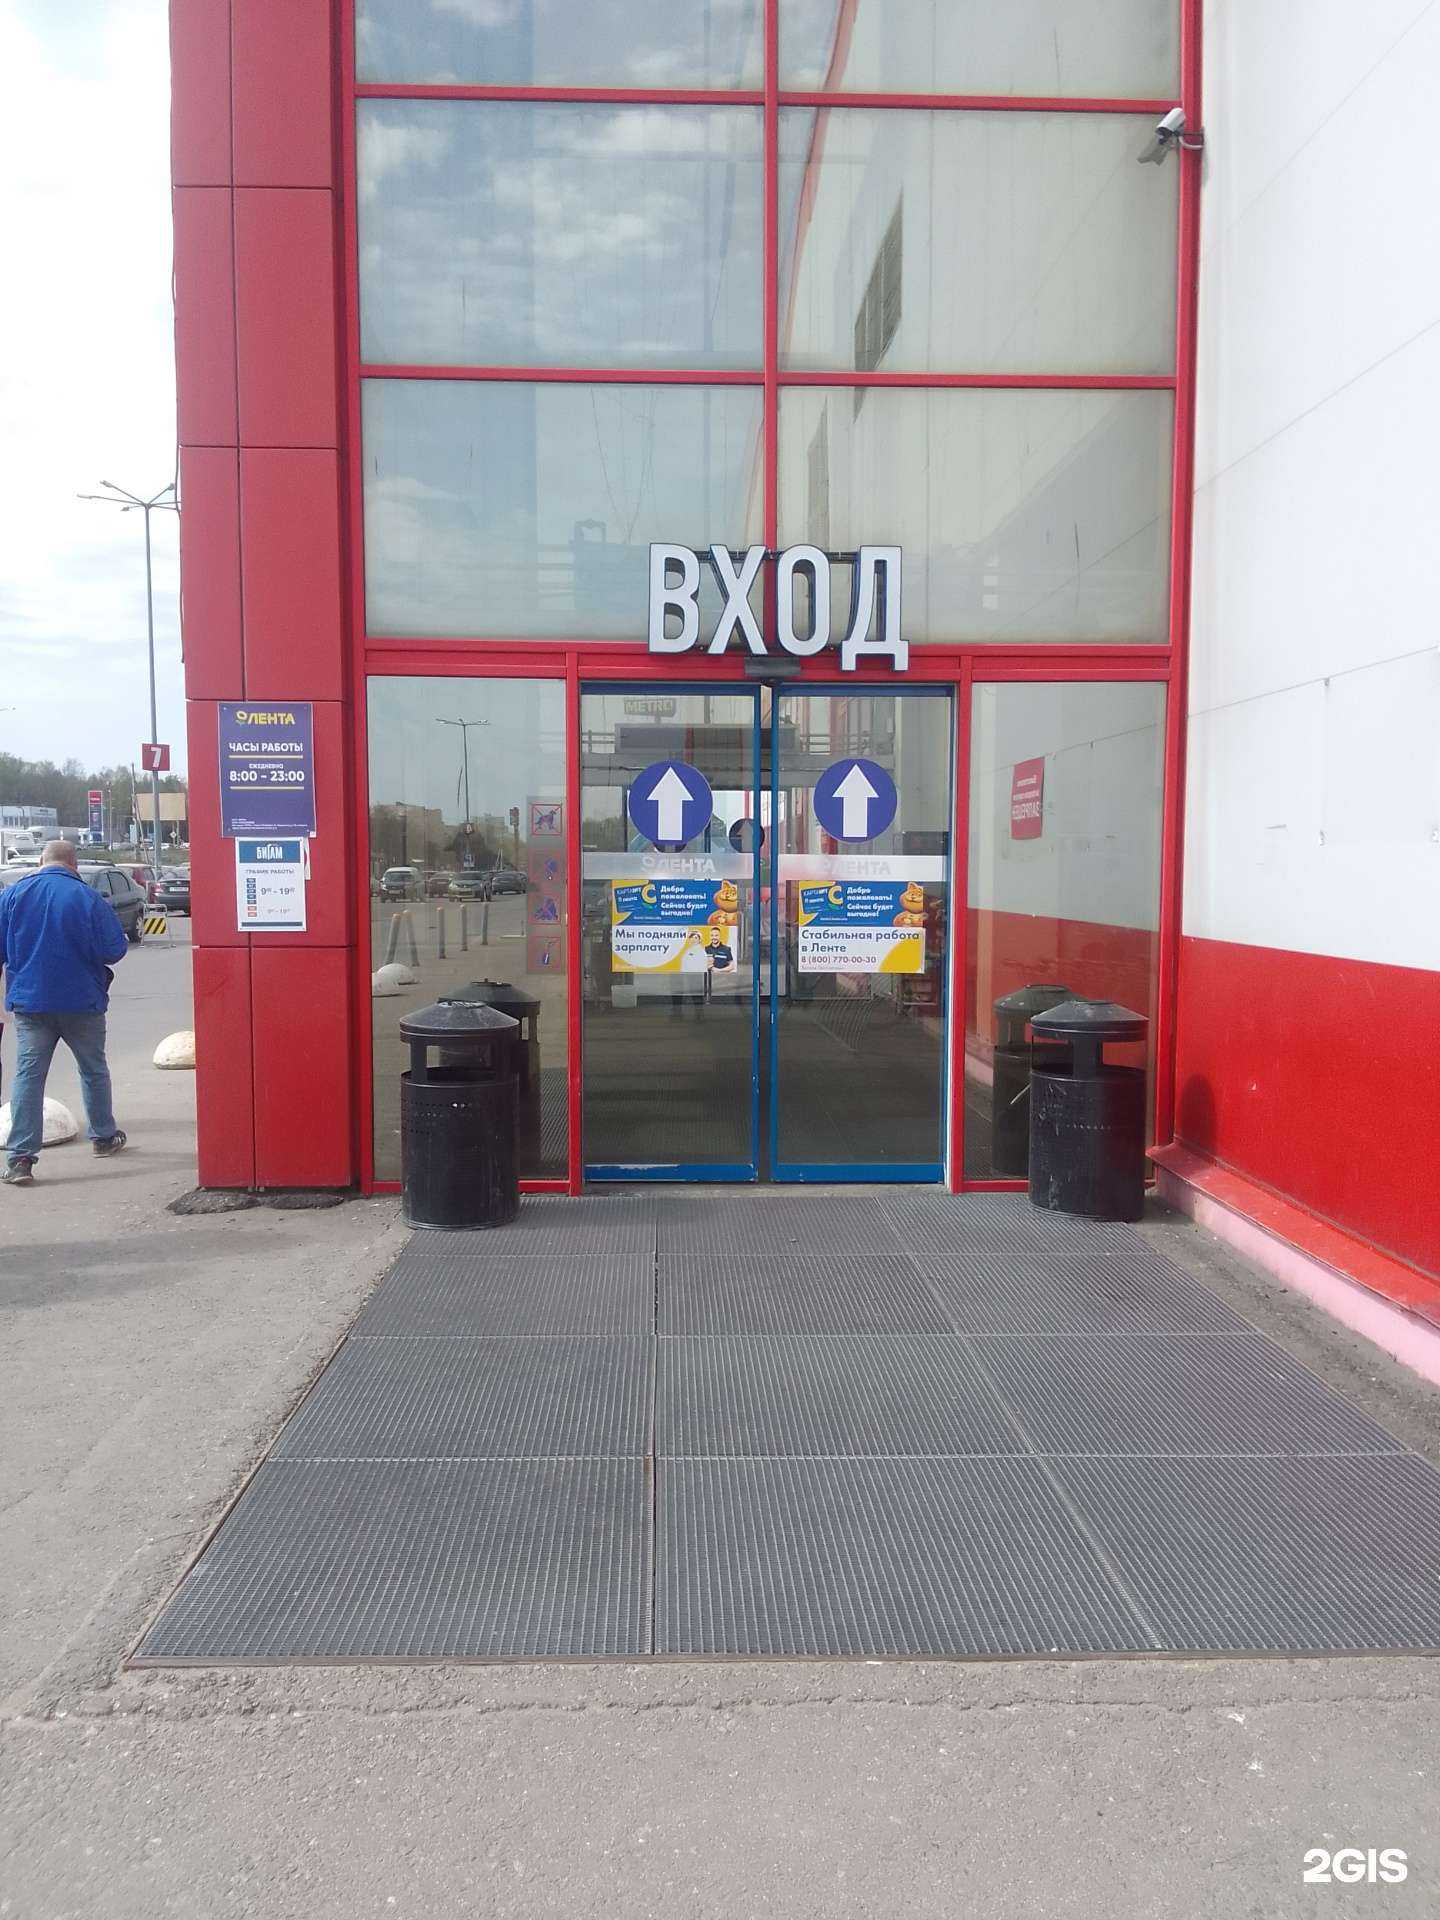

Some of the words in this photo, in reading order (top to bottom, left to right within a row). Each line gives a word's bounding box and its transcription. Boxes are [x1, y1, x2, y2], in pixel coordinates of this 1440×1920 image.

[648, 543, 909, 672] ВХОД
[247, 712, 296, 725] ЛЕНТА
[229, 742, 260, 752] ЧАСЫ
[261, 742, 304, 752] РАБОТЫ
[151, 747, 162, 768] 7
[229, 770, 258, 782] 8:00
[270, 770, 305, 782] 23:00
[657, 859, 716, 873] ЛЕНТА
[615, 929, 635, 938] Мы
[638, 930, 687, 940] подняли
[801, 929, 873, 940] Стабильная
[875, 930, 920, 942] работа
[615, 944, 670, 954] зарплату
[811, 943, 847, 953] Ленте
[808, 955, 831, 964] (800)
[833, 956, 877, 964] 770-00-30
